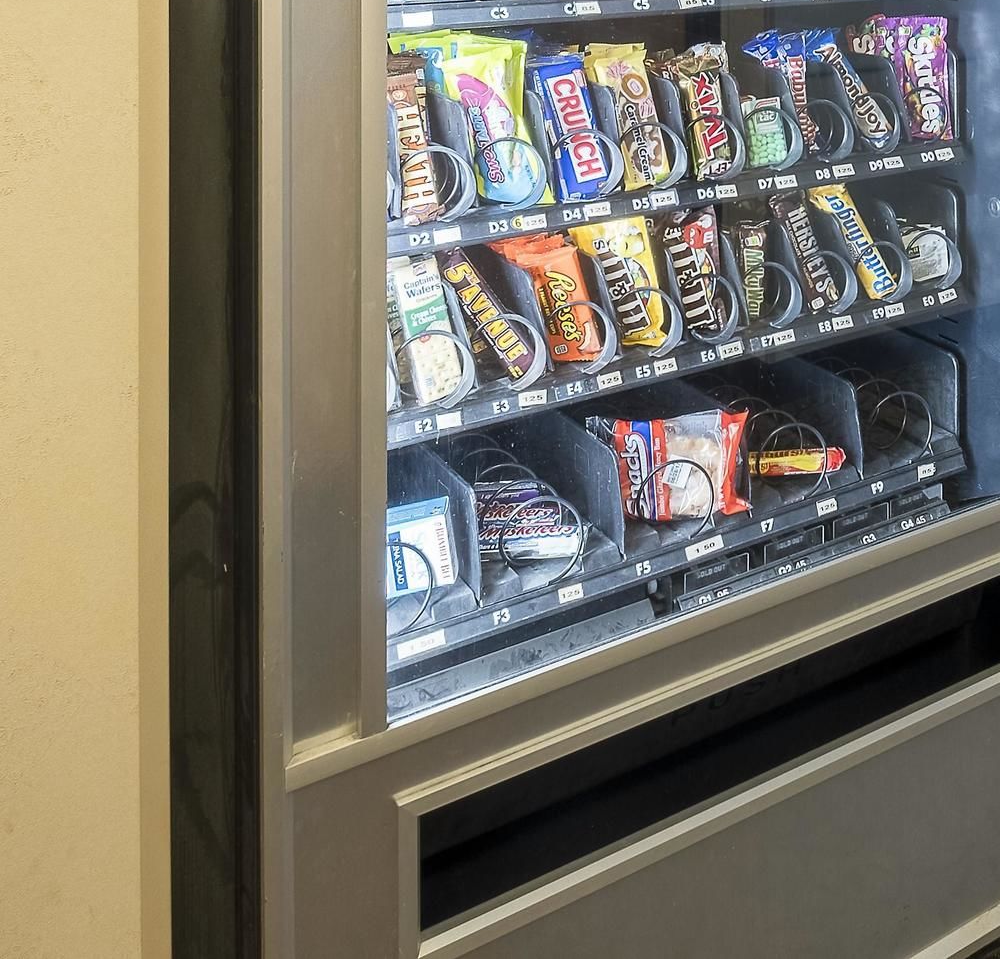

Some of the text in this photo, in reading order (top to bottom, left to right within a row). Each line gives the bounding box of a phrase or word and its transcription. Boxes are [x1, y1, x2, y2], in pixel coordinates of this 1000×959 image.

[633, 0, 650, 10] C5
[490, 6, 509, 19] C3
[551, 78, 602, 177] CRUNCH
[920, 151, 934, 162] D0
[869, 160, 883, 171] D9
[815, 169, 830, 180] D8
[757, 179, 773, 189] D7
[697, 188, 714, 200] D6
[632, 199, 650, 210] D5
[563, 209, 582, 221] D4
[488, 221, 509, 233] D3
[409, 232, 431, 245] D2
[825, 195, 896, 294] Butterfinger
[406, 282, 441, 298] Wafers
[545, 270, 582, 343] Reese's
[922, 296, 935, 306] E0
[872, 309, 885, 320] E9
[456, 283, 528, 362] AVENUE
[818, 322, 832, 333] E8
[761, 337, 774, 347] E7
[700, 351, 716, 363] E6
[635, 367, 651, 378] E5
[567, 383, 582, 395] E4
[493, 401, 510, 414] E3
[415, 420, 432, 433] E2
[620, 433, 651, 519] Snacks
[871, 482, 884, 494] F9
[760, 518, 775, 533] F7
[635, 560, 651, 576] F5
[492, 608, 511, 625] F3
